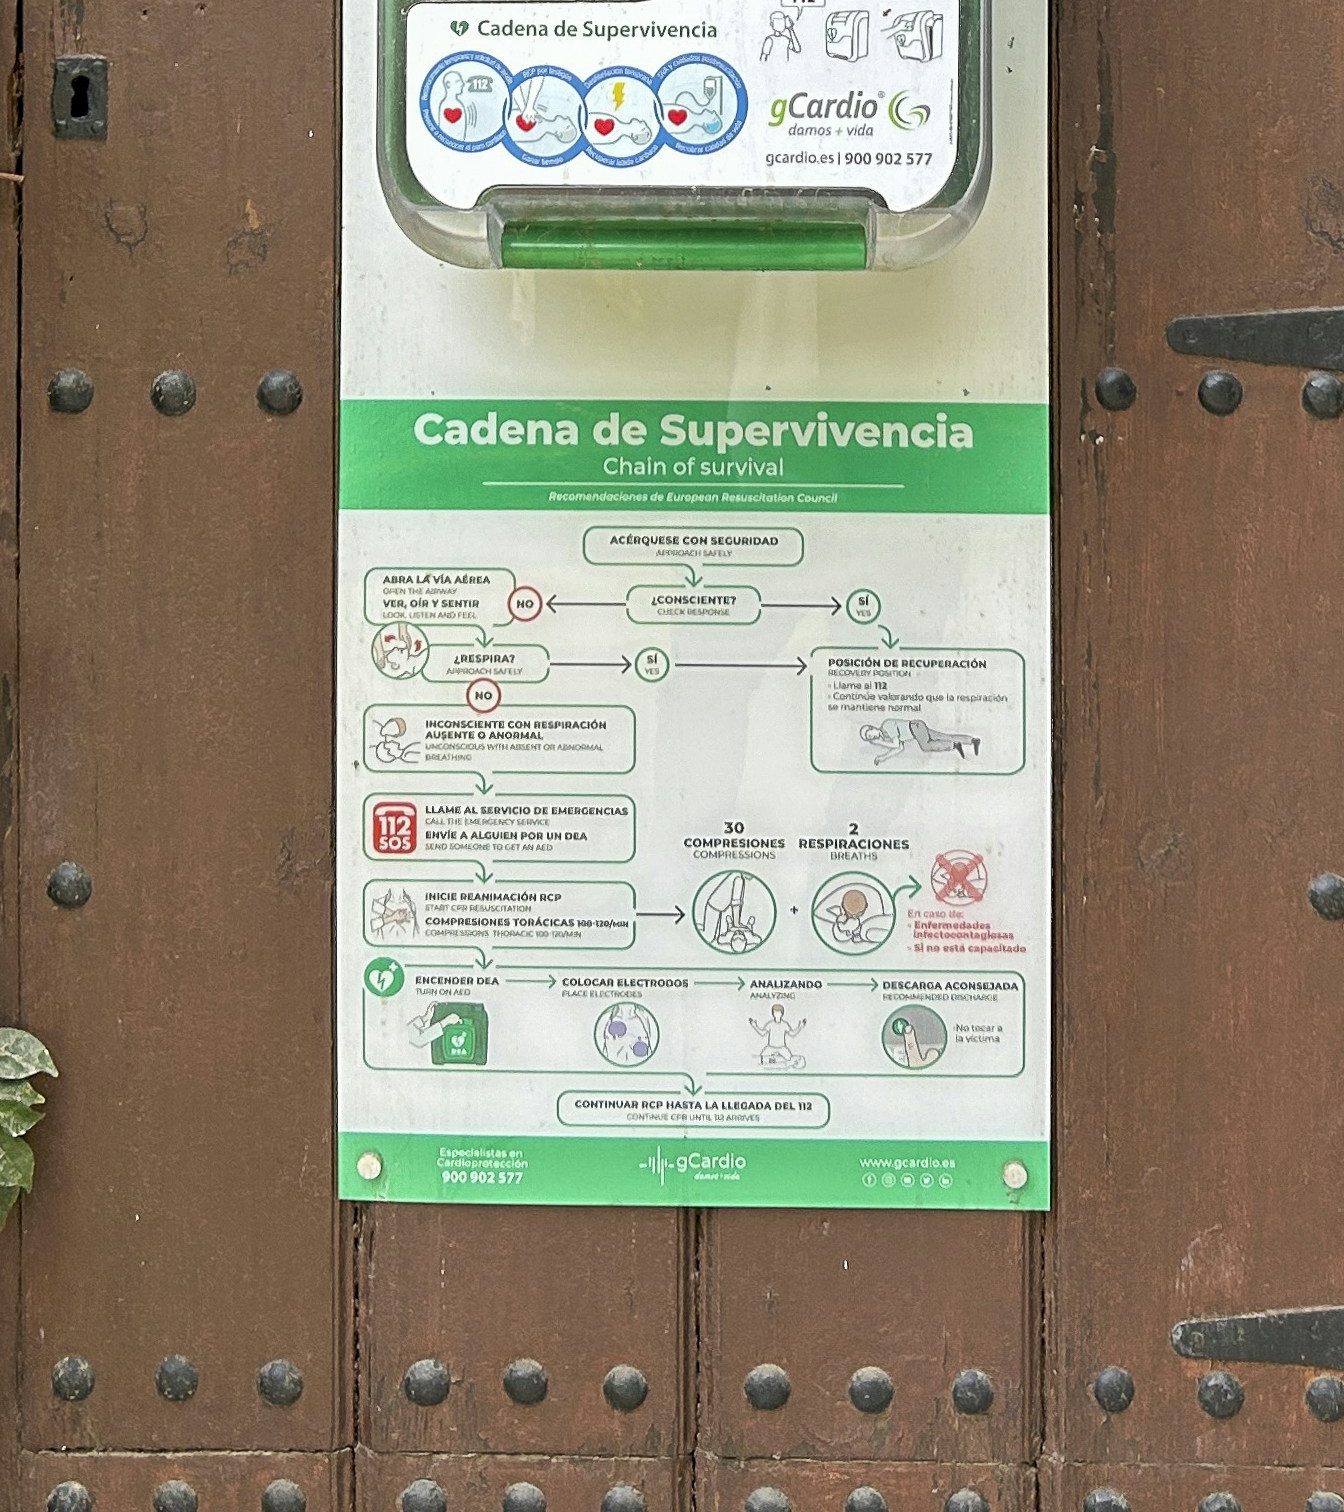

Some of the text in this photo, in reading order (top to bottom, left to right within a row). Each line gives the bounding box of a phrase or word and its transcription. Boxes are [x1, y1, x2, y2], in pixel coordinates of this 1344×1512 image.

[478, 20, 716, 41] Cadena de Supervivencia
[789, 123, 831, 136] damos
[847, 124, 873, 136] vida
[766, 151, 834, 166] gcardio.es
[845, 153, 871, 165] 900
[876, 153, 901, 165] 902
[906, 153, 932, 165] 577
[414, 412, 972, 453] Cadena de Supervivencia
[604, 456, 783, 476] Chain of survival
[549, 491, 837, 503] Recomendaciones de European Resuscitation Council
[610, 534, 778, 546] ACÉRQUESE CON SEGURIDAD
[383, 576, 413, 584] ABRA
[433, 574, 451, 584] VÍA
[454, 574, 490, 584] AÉREA
[383, 598, 479, 609] VER, OÍR Y SENTIR
[517, 600, 534, 608] NO
[651, 596, 736, 606] ¿CONSCIENTE?
[858, 595, 870, 606] SÍ
[454, 654, 515, 665] ¿RESPIRA?
[647, 653, 657, 664] SÍ
[829, 657, 986, 668] POSICIÓN DE RECUPERACIÓN
[475, 692, 492, 700] NO
[426, 719, 606, 729] INCONSCIENTE CON RESPIRACIÓN
[425, 731, 543, 740] AUSENTE O ANORMAL
[426, 806, 628, 815] LLAME AL SERVICIO DE EMERGENCIAS
[379, 817, 411, 836] 112
[724, 822, 744, 835] 30
[848, 823, 859, 836] 2
[460, 831, 468, 839] A
[471, 831, 517, 840] ALGUIEN
[521, 832, 543, 840] POR
[547, 832, 561, 841] UN
[565, 832, 587, 840] DEA
[379, 837, 412, 851] SOS
[684, 838, 785, 848] COMPRESIONES
[799, 839, 909, 849] RESPIRACIONES
[693, 850, 776, 859] COMPRESSIONS
[831, 852, 878, 861] BREATHS
[460, 891, 536, 901] REANIMACIÓN
[425, 917, 510, 926] COMPRESIONES
[513, 916, 574, 927] TORÁCICAS
[416, 976, 499, 985] ENCENDER DEA
[562, 978, 688, 988] COLOCAR ELECTRODOS
[750, 980, 822, 989] ANALIZANDO
[883, 981, 1018, 991] DESCARGA ACONSEJADA
[575, 1100, 812, 1110] CONTINUAR RCP HASTA LA LLEGADA DEL 112
[439, 1147, 522, 1159] Especialistas en
[436, 1157, 529, 1169] Cardioprotección
[676, 1152, 747, 1173] gCardio
[860, 1157, 955, 1170] www.gcardio.es
[442, 1171, 523, 1184] 900 902 577
